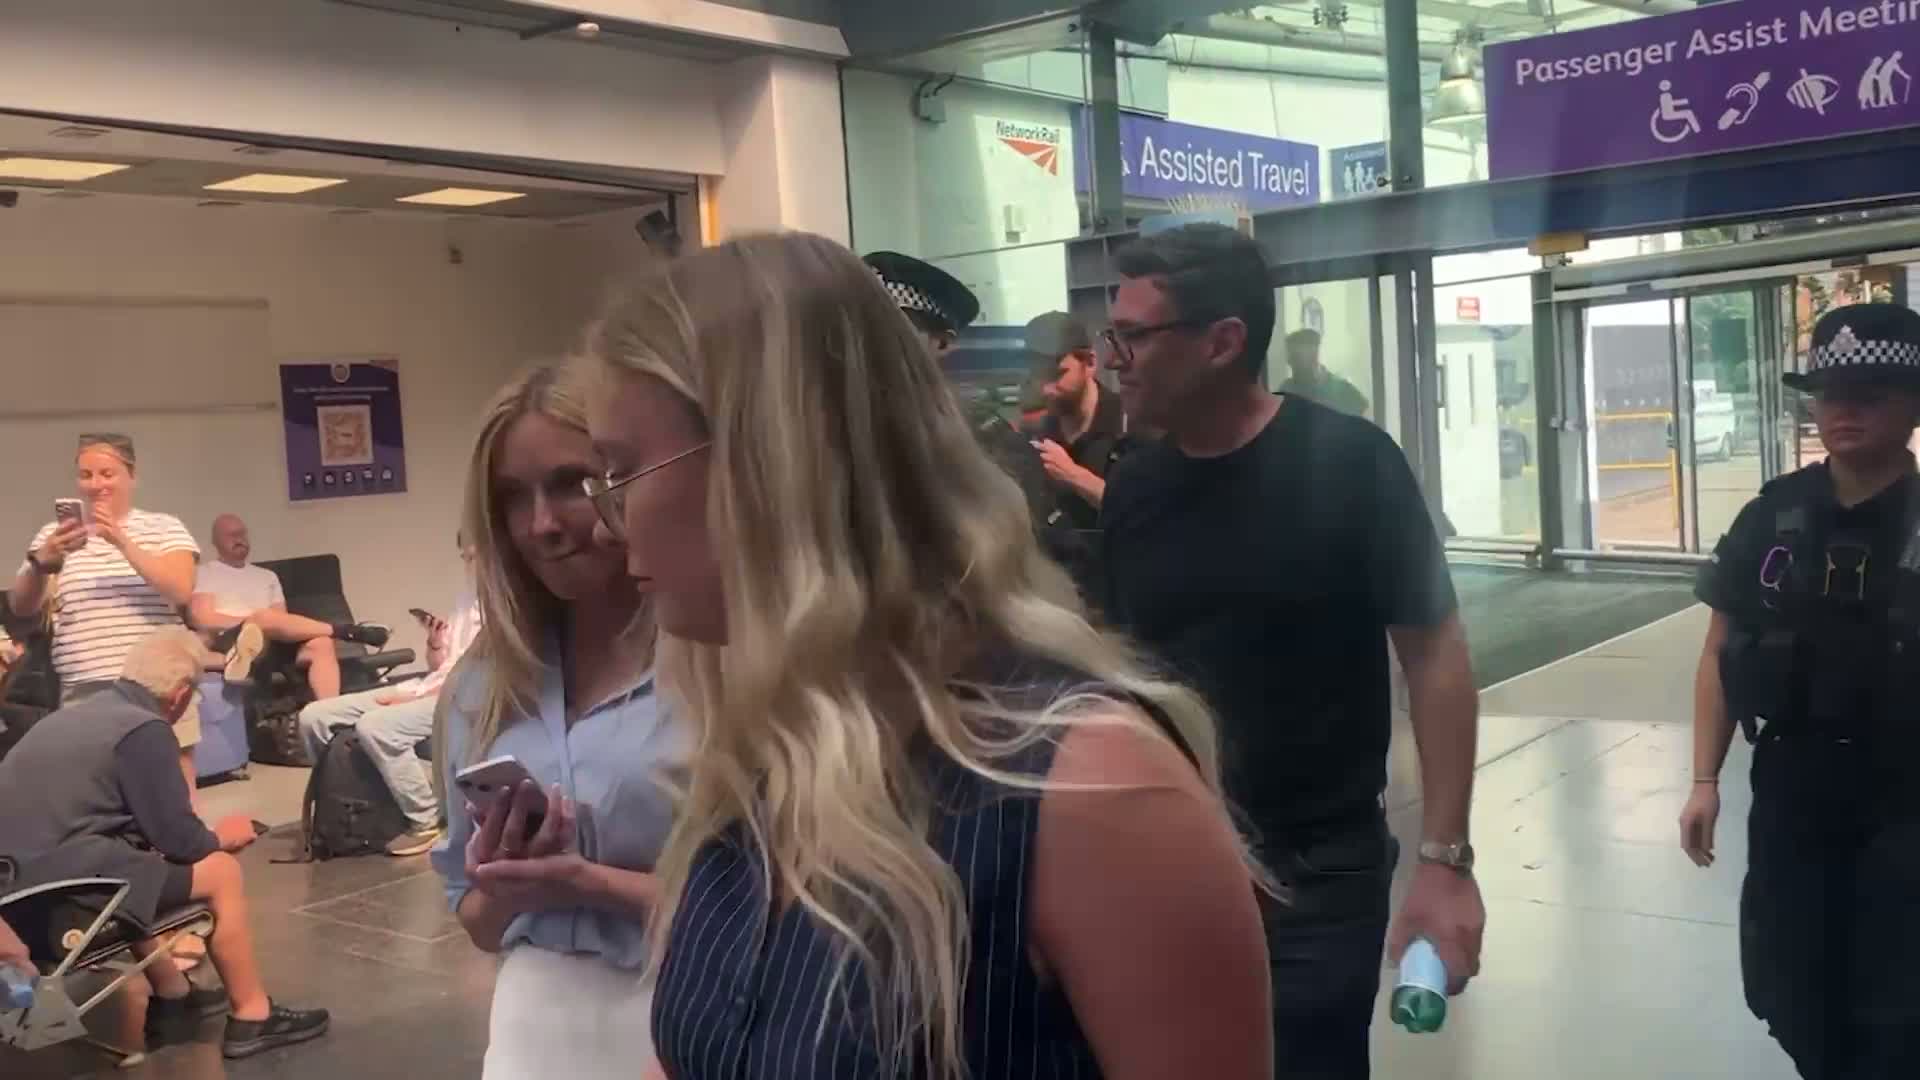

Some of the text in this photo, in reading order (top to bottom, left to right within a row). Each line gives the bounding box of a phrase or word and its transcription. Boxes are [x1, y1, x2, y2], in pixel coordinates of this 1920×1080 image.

[1516, 40, 1677, 86] Passenger
[1683, 17, 1788, 59] Assist
[1140, 136, 1310, 195] Assisted Travel
